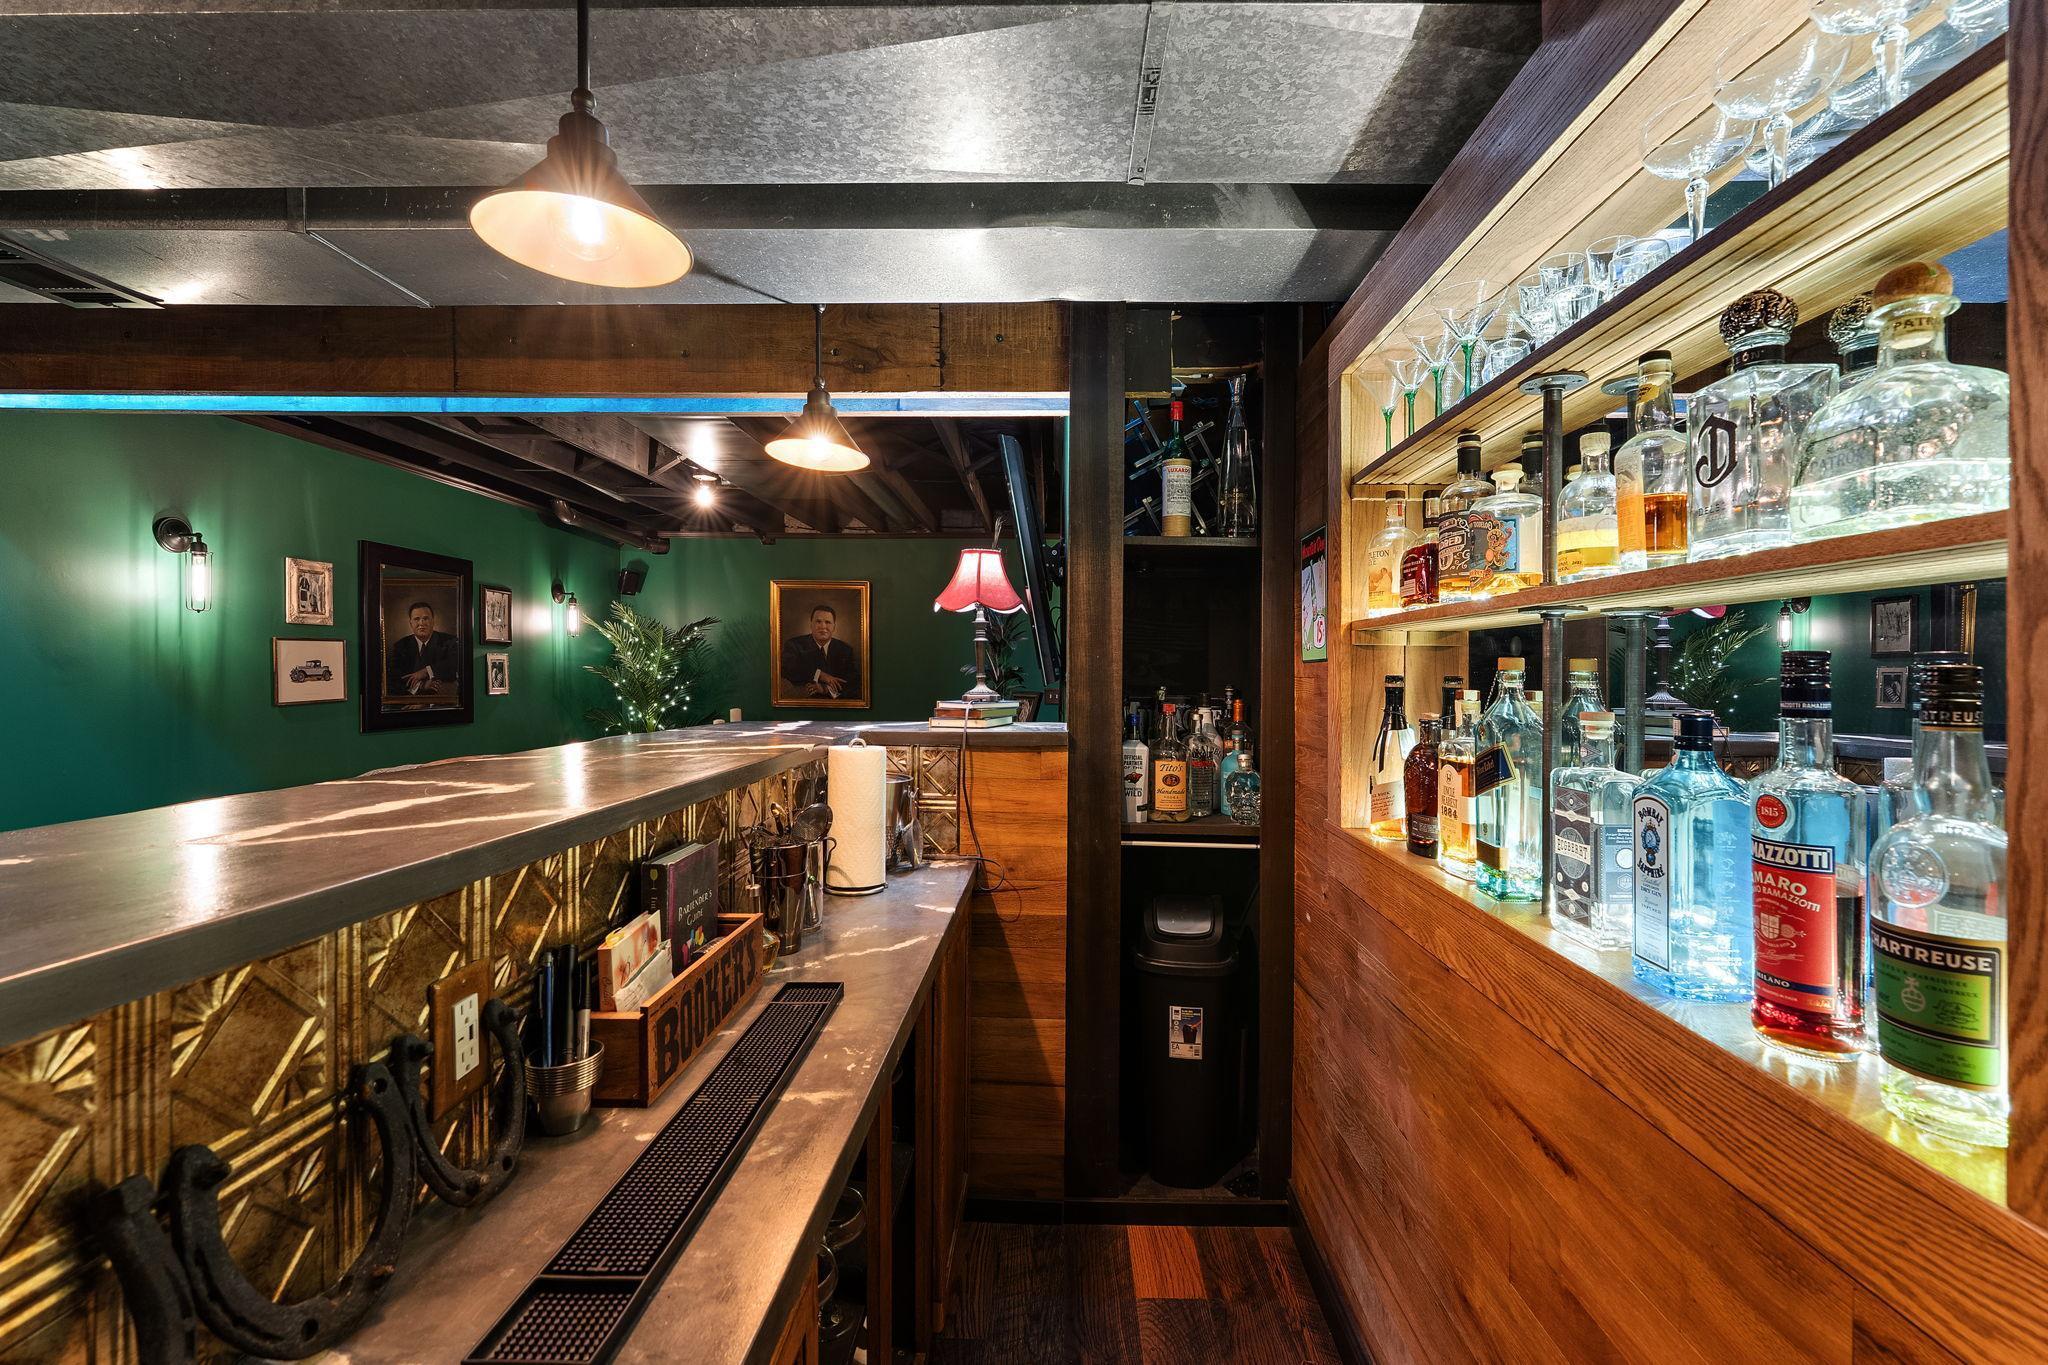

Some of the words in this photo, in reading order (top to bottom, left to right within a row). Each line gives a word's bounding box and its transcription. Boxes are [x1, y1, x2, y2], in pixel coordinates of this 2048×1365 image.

[1159, 763, 1184, 772] Tito's
[1125, 789, 1143, 798] WILD
[1441, 805, 1458, 820] 1884
[1638, 806, 1664, 827] BOMBAY
[1761, 806, 1779, 817] 1815
[1637, 857, 1666, 879] SAPPHIRE
[678, 887, 713, 922] BARTENDER'S
[1762, 885, 1821, 913] RAMAZZOTTI
